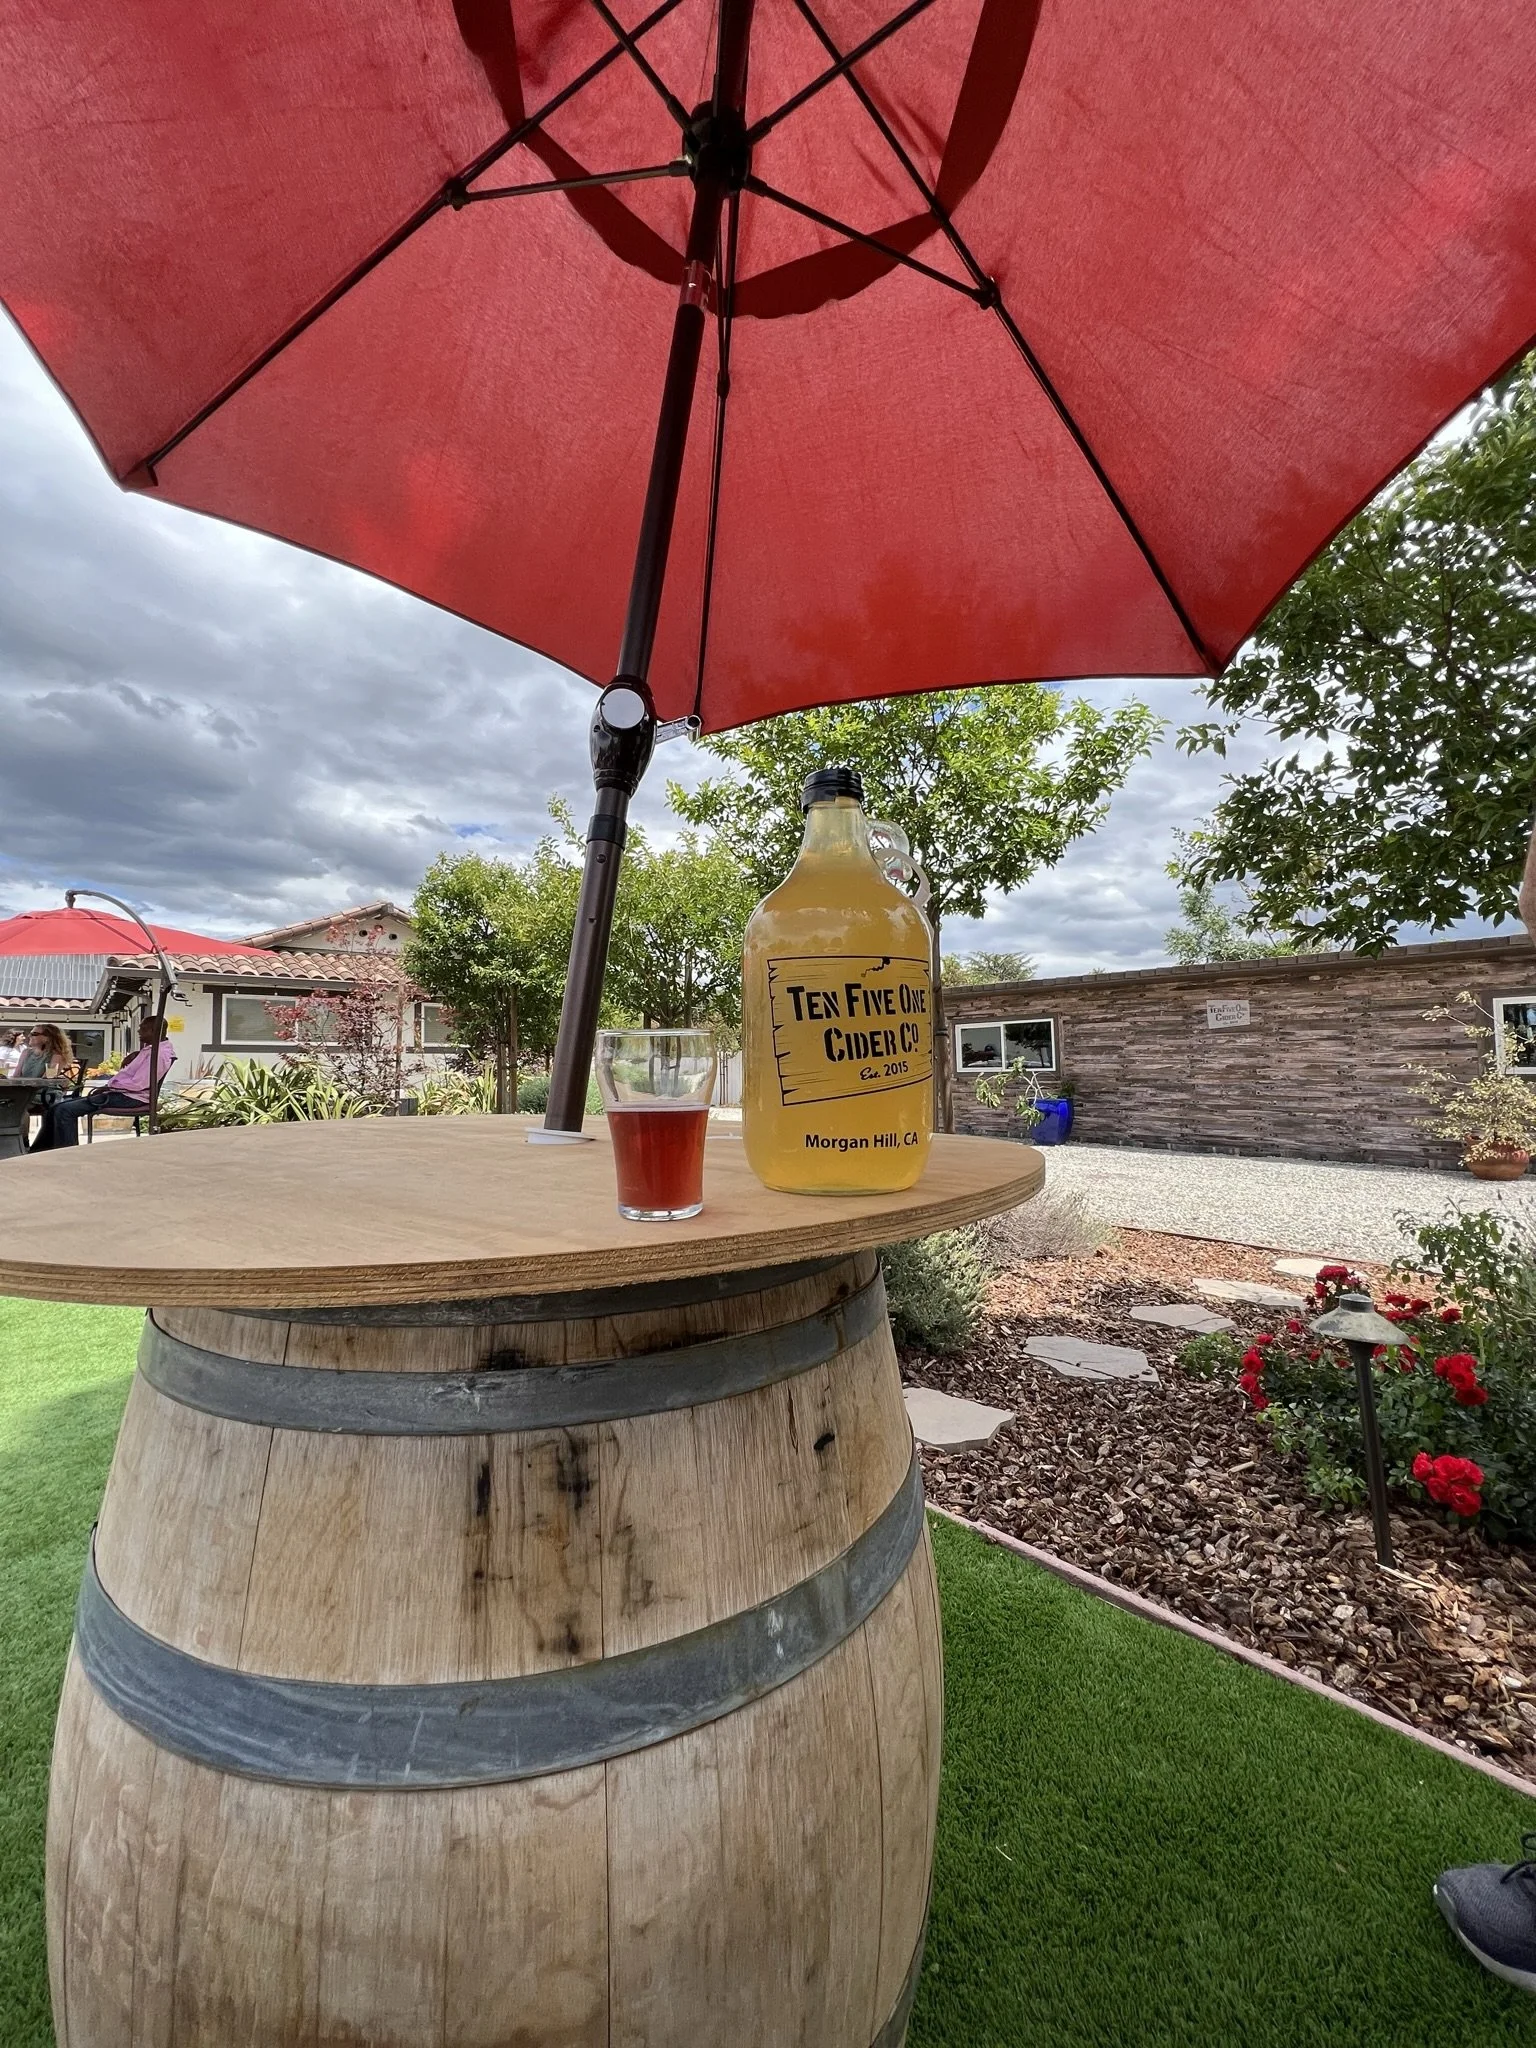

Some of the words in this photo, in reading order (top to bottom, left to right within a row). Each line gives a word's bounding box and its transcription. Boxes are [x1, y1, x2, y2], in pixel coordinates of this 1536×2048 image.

[786, 985, 841, 1022] TEN
[844, 983, 896, 1018] FIVE
[899, 983, 927, 1014] ONE
[823, 1028, 898, 1062] CIDER
[860, 1066, 881, 1081] Est.
[883, 1061, 909, 1077] 2015
[805, 1133, 869, 1152] Morgan
[873, 1132, 900, 1149] Hill,
[903, 1131, 919, 1146] CA
